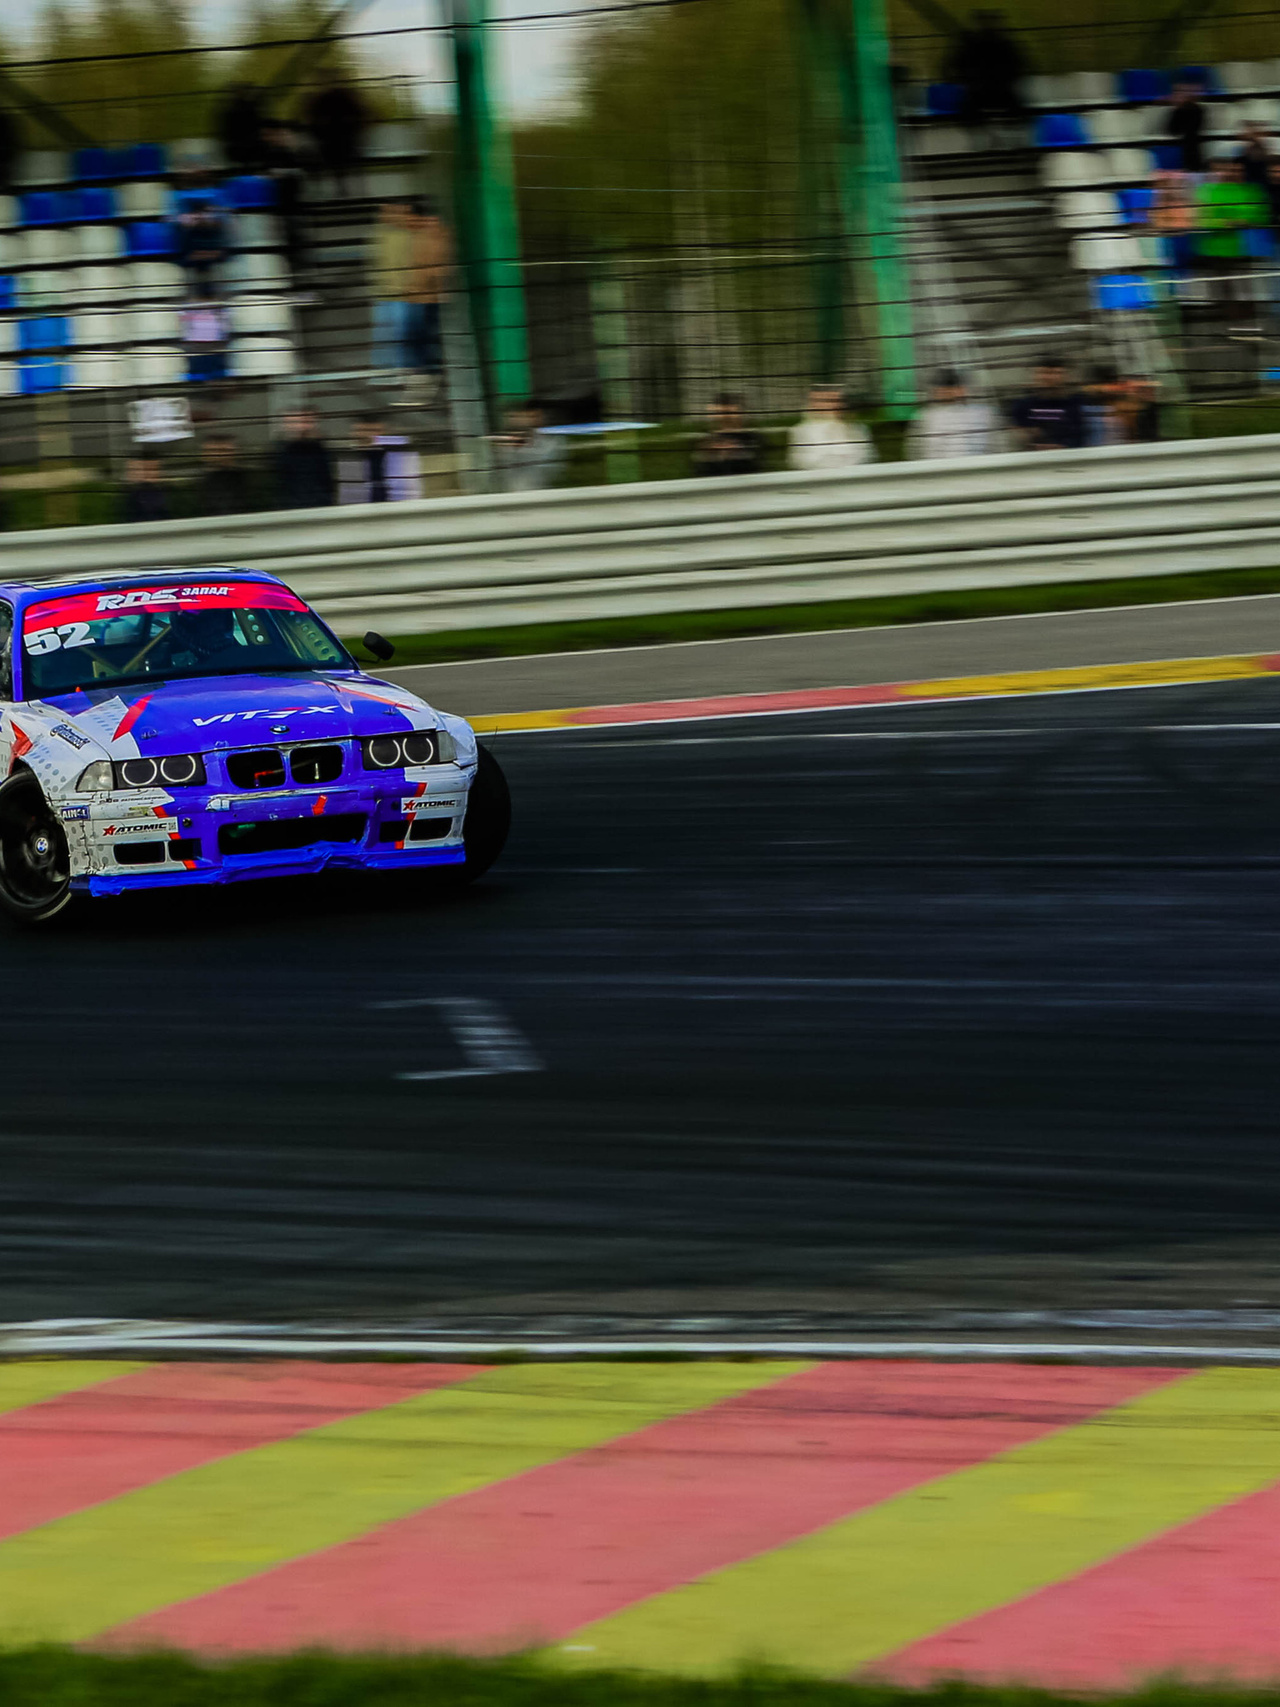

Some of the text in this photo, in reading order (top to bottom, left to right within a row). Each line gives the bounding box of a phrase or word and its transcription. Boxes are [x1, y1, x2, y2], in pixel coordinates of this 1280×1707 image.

[181, 586, 233, 596] ЗАПАД
[23, 622, 96, 656] 52
[415, 799, 457, 808] ATOMIC
[116, 822, 168, 833] ATOMIC
